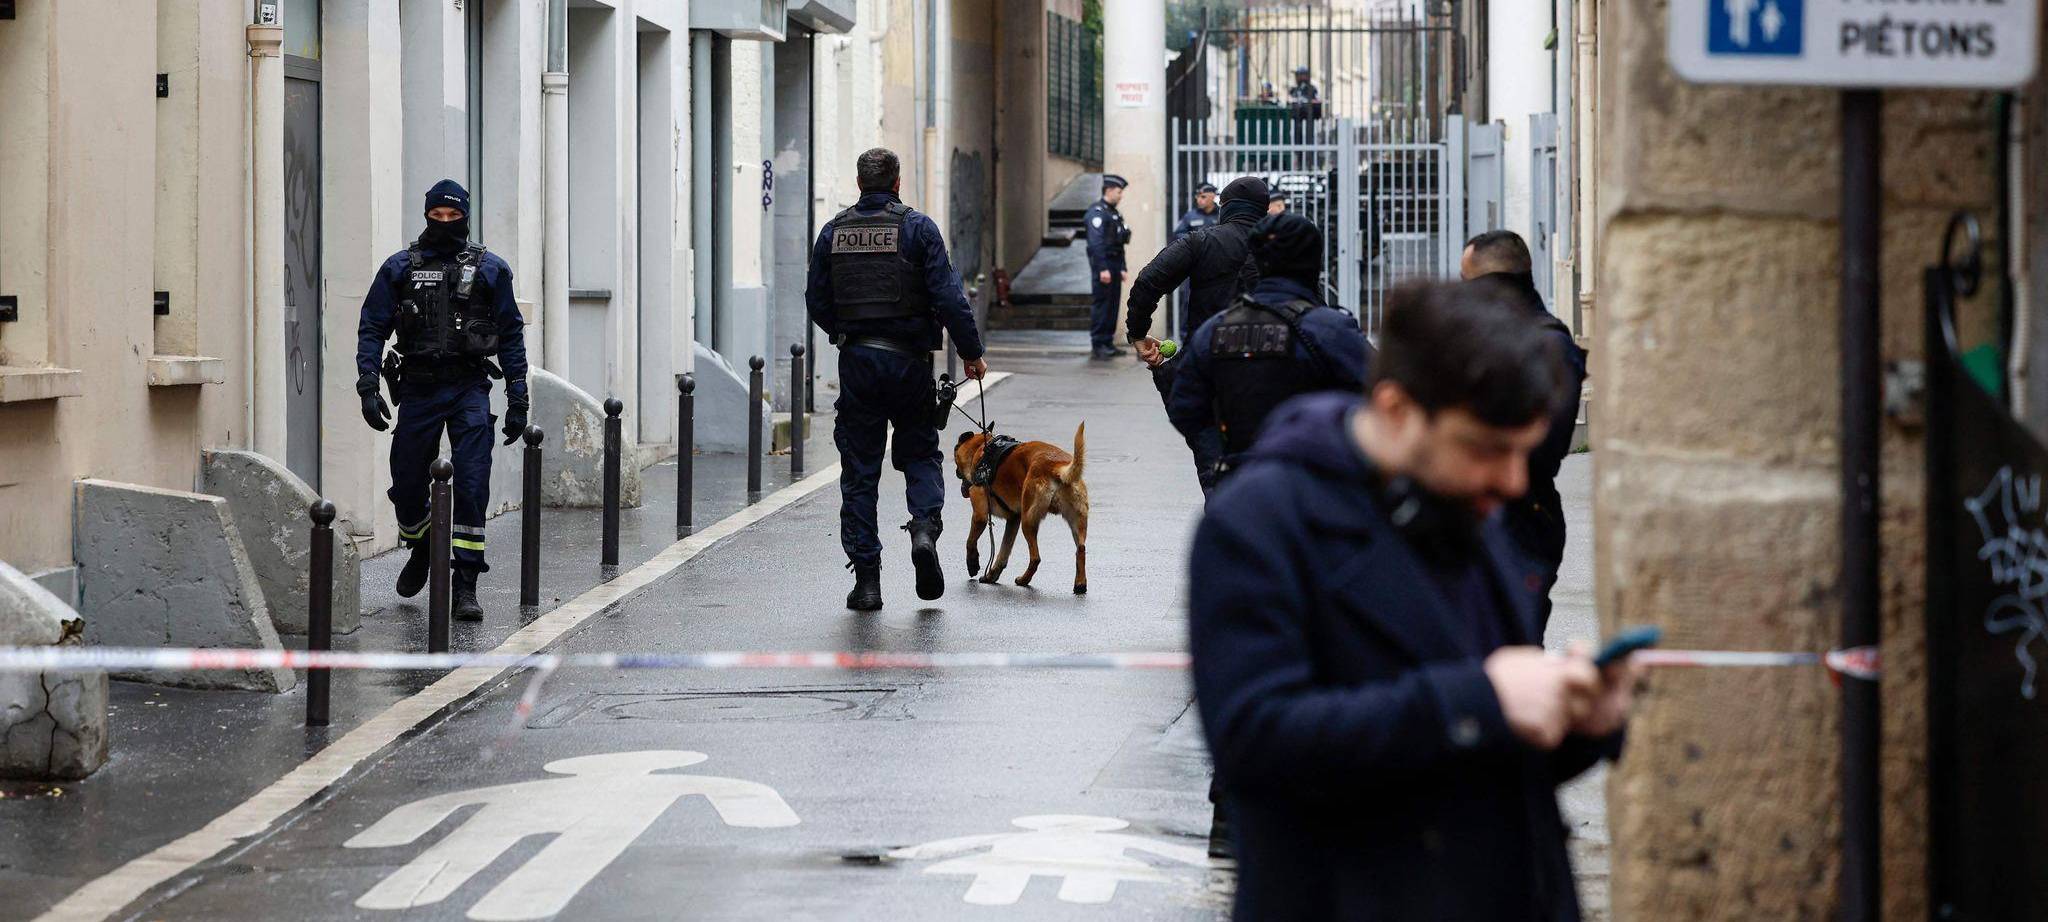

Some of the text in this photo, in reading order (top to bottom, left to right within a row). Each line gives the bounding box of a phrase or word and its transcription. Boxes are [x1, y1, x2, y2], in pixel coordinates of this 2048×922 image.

[1839, 13, 1997, 57] PIÉTONS
[836, 232, 893, 247] POLICE
[411, 272, 443, 280] POLICE
[1213, 324, 1289, 353] POLICE
